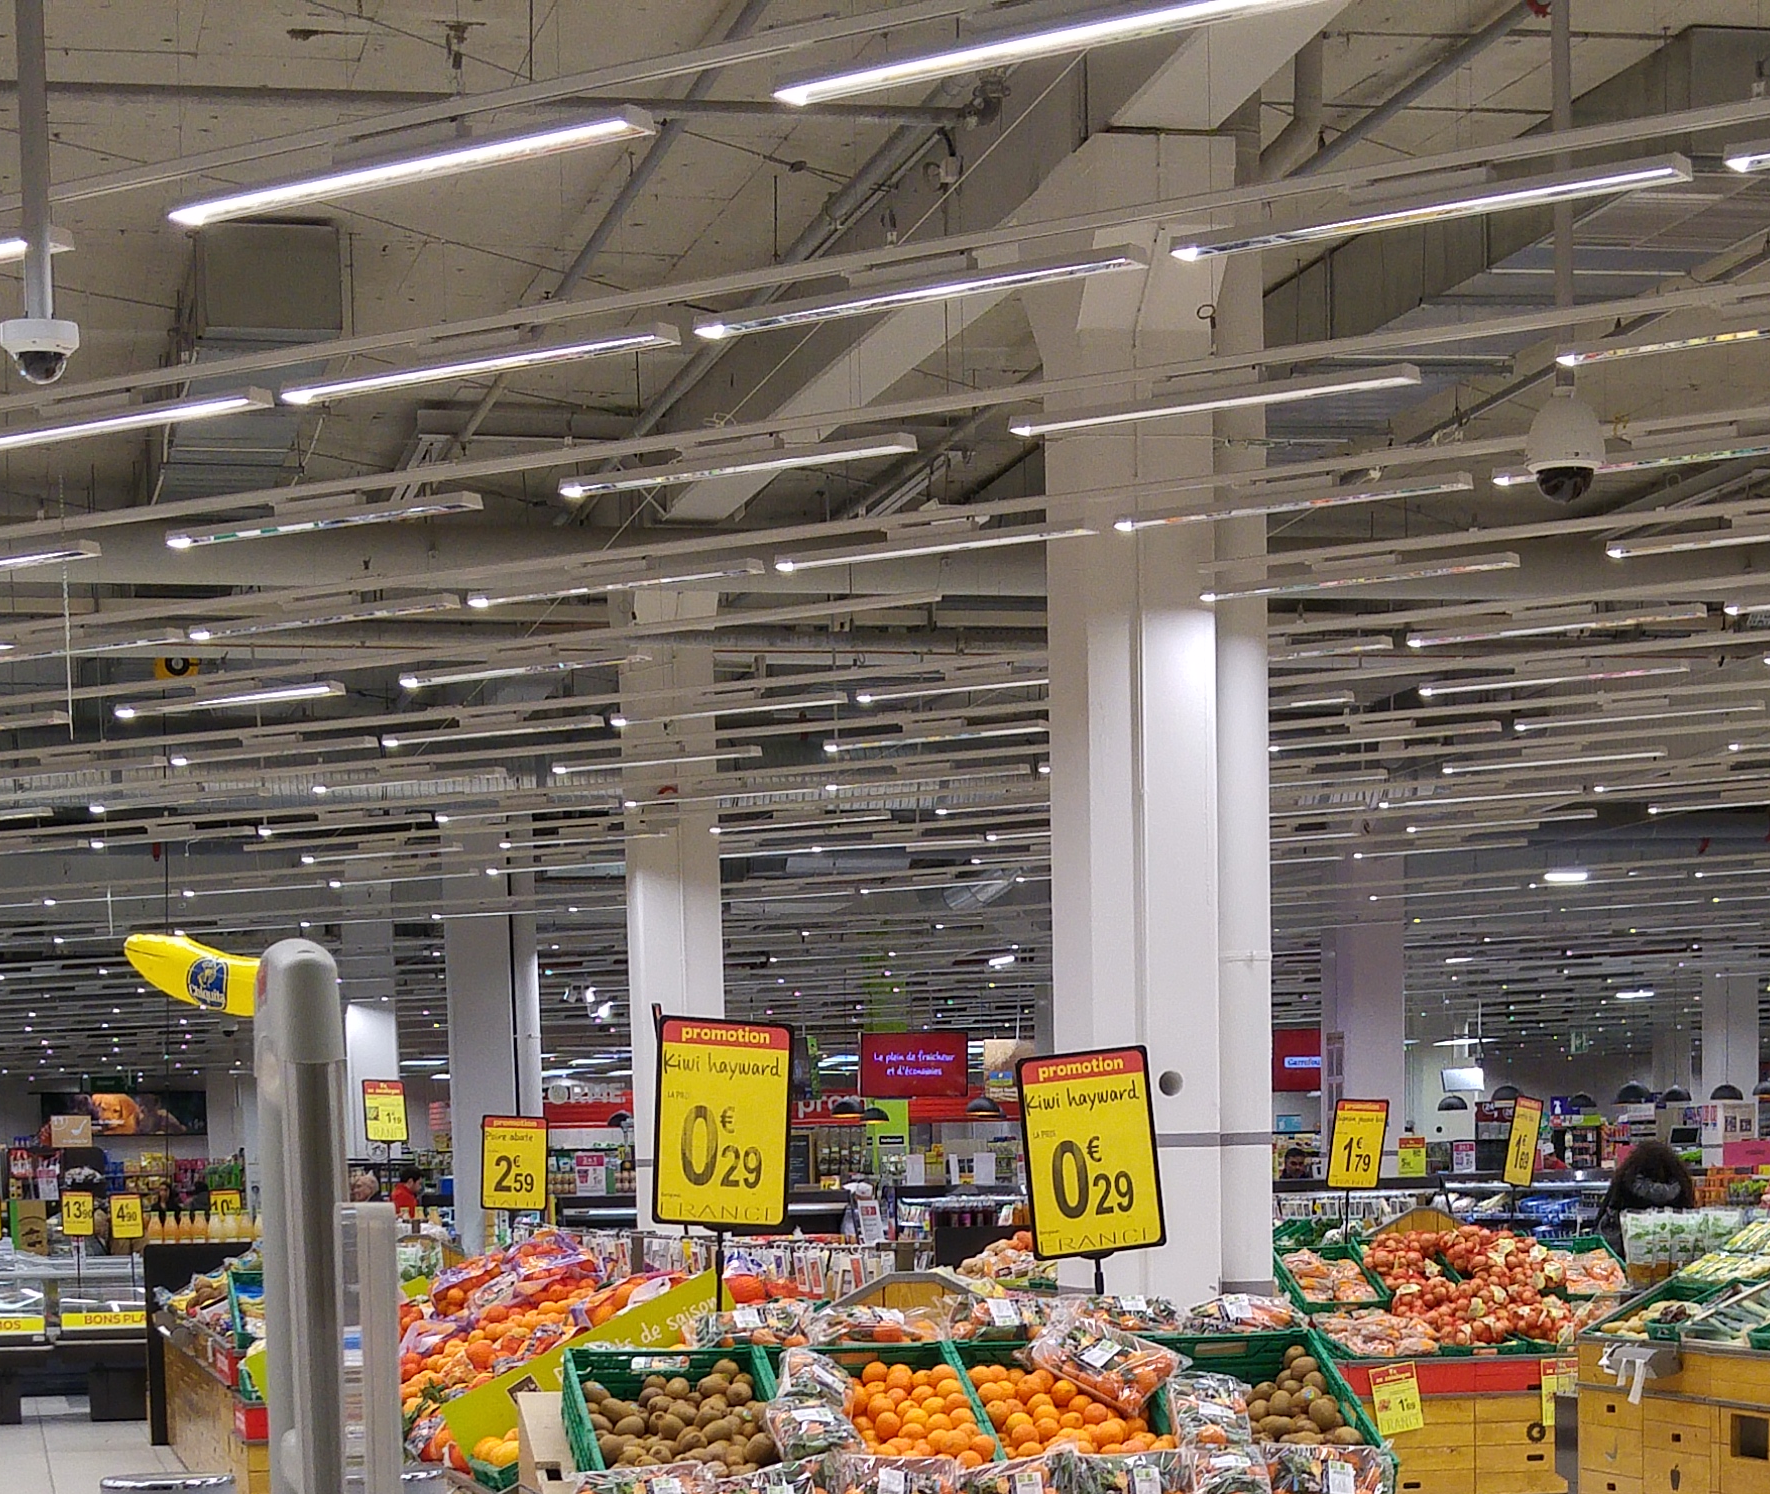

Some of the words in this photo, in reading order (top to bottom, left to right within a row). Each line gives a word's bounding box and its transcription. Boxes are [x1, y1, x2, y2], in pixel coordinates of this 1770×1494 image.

[682, 1026, 770, 1044] promotion
[664, 1050, 700, 1075] Kiwi
[708, 1052, 782, 1080] hayward
[874, 1052, 883, 1061] Le
[886, 1052, 904, 1063] plein
[906, 1052, 916, 1061] de
[1288, 1058, 1321, 1066] Carrefou
[886, 1066, 895, 1075] et
[1038, 1056, 1123, 1081] promotion
[1024, 1092, 1060, 1116] Kiwi
[1067, 1079, 1140, 1111] hayward
[493, 1120, 537, 1128] promotion
[84, 1313, 121, 1325] BONS
[123, 1313, 146, 1324] PLA
[640, 1322, 662, 1345] de
[666, 1296, 717, 1332] saison
